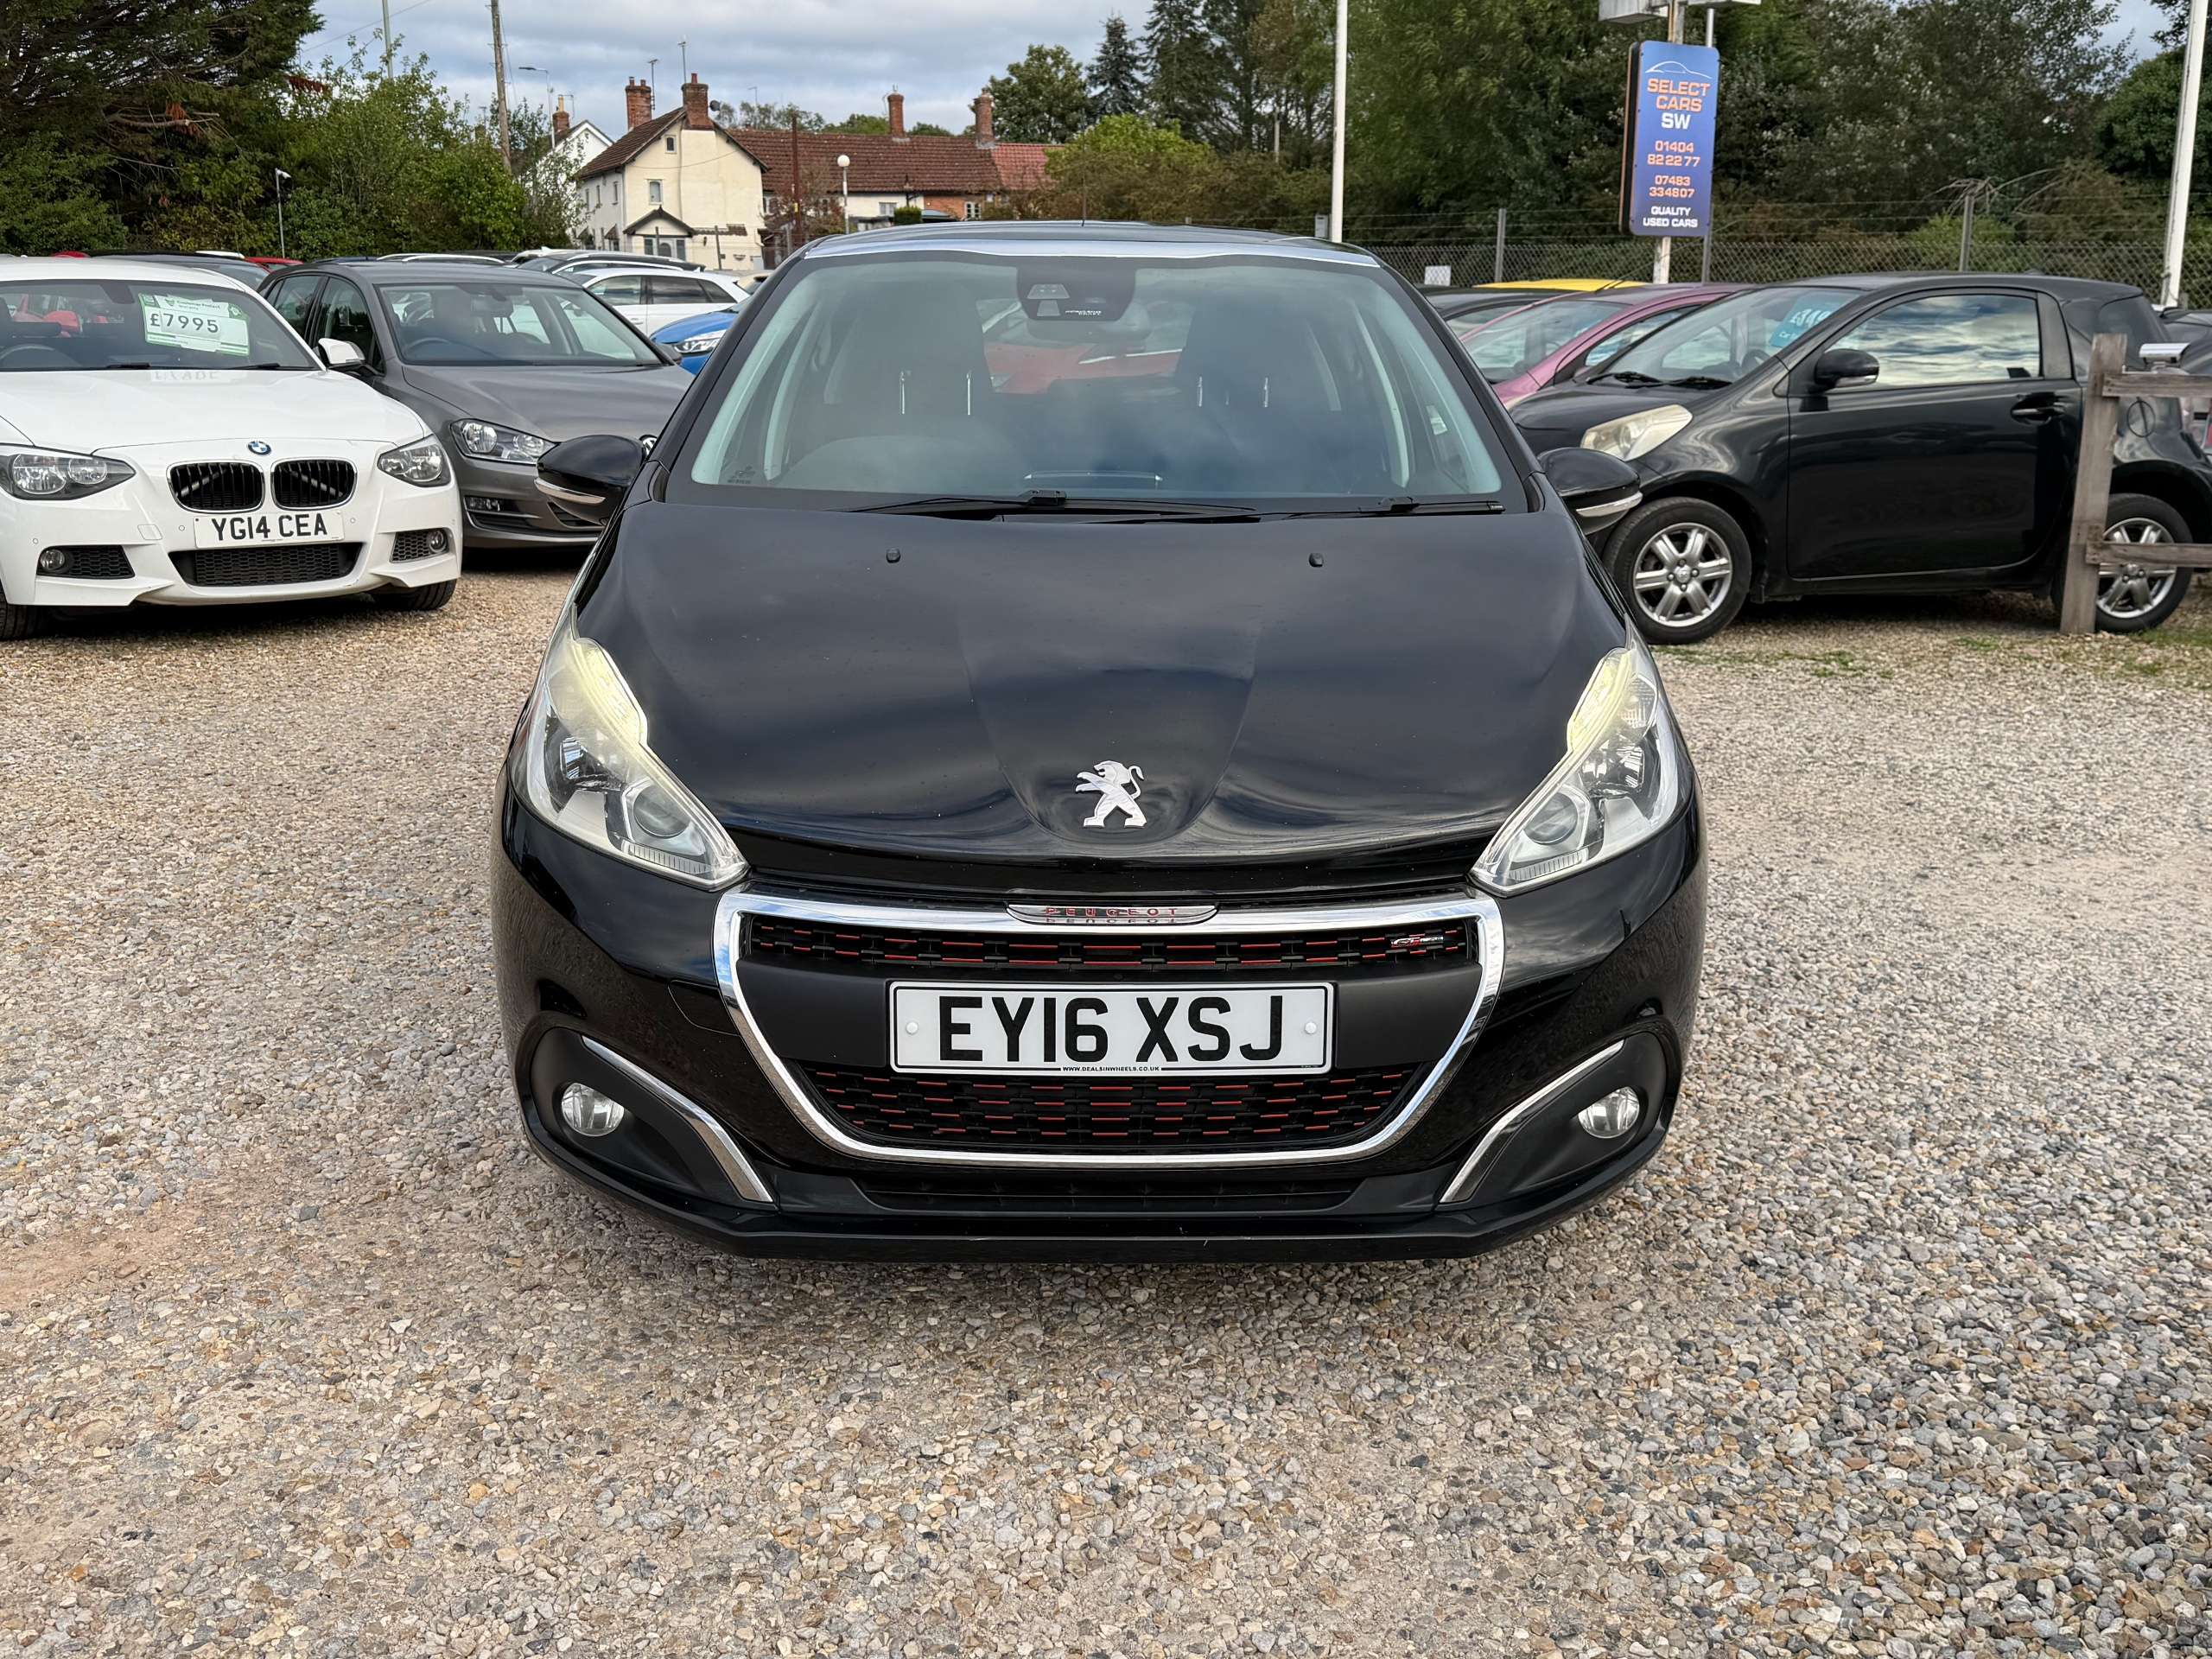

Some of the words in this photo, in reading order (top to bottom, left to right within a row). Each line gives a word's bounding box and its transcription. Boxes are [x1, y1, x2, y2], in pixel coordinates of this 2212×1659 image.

[1647, 78, 1711, 96] SELECT
[1656, 95, 1702, 112] CARS
[1661, 111, 1691, 130] SW
[1655, 140, 1694, 153] 01404
[1655, 175, 1691, 186] 07483
[1649, 186, 1694, 198] 334807
[1651, 206, 1691, 216] QUALITY
[1643, 217, 1669, 227] USED
[1671, 218, 1698, 228] CARS
[149, 313, 219, 334] £7995
[211, 516, 271, 542] YG14
[278, 512, 328, 537] CEA
[1043, 906, 1179, 917] PEUGEOT
[939, 995, 1109, 1063] EY16
[1135, 995, 1284, 1063] XSJ
